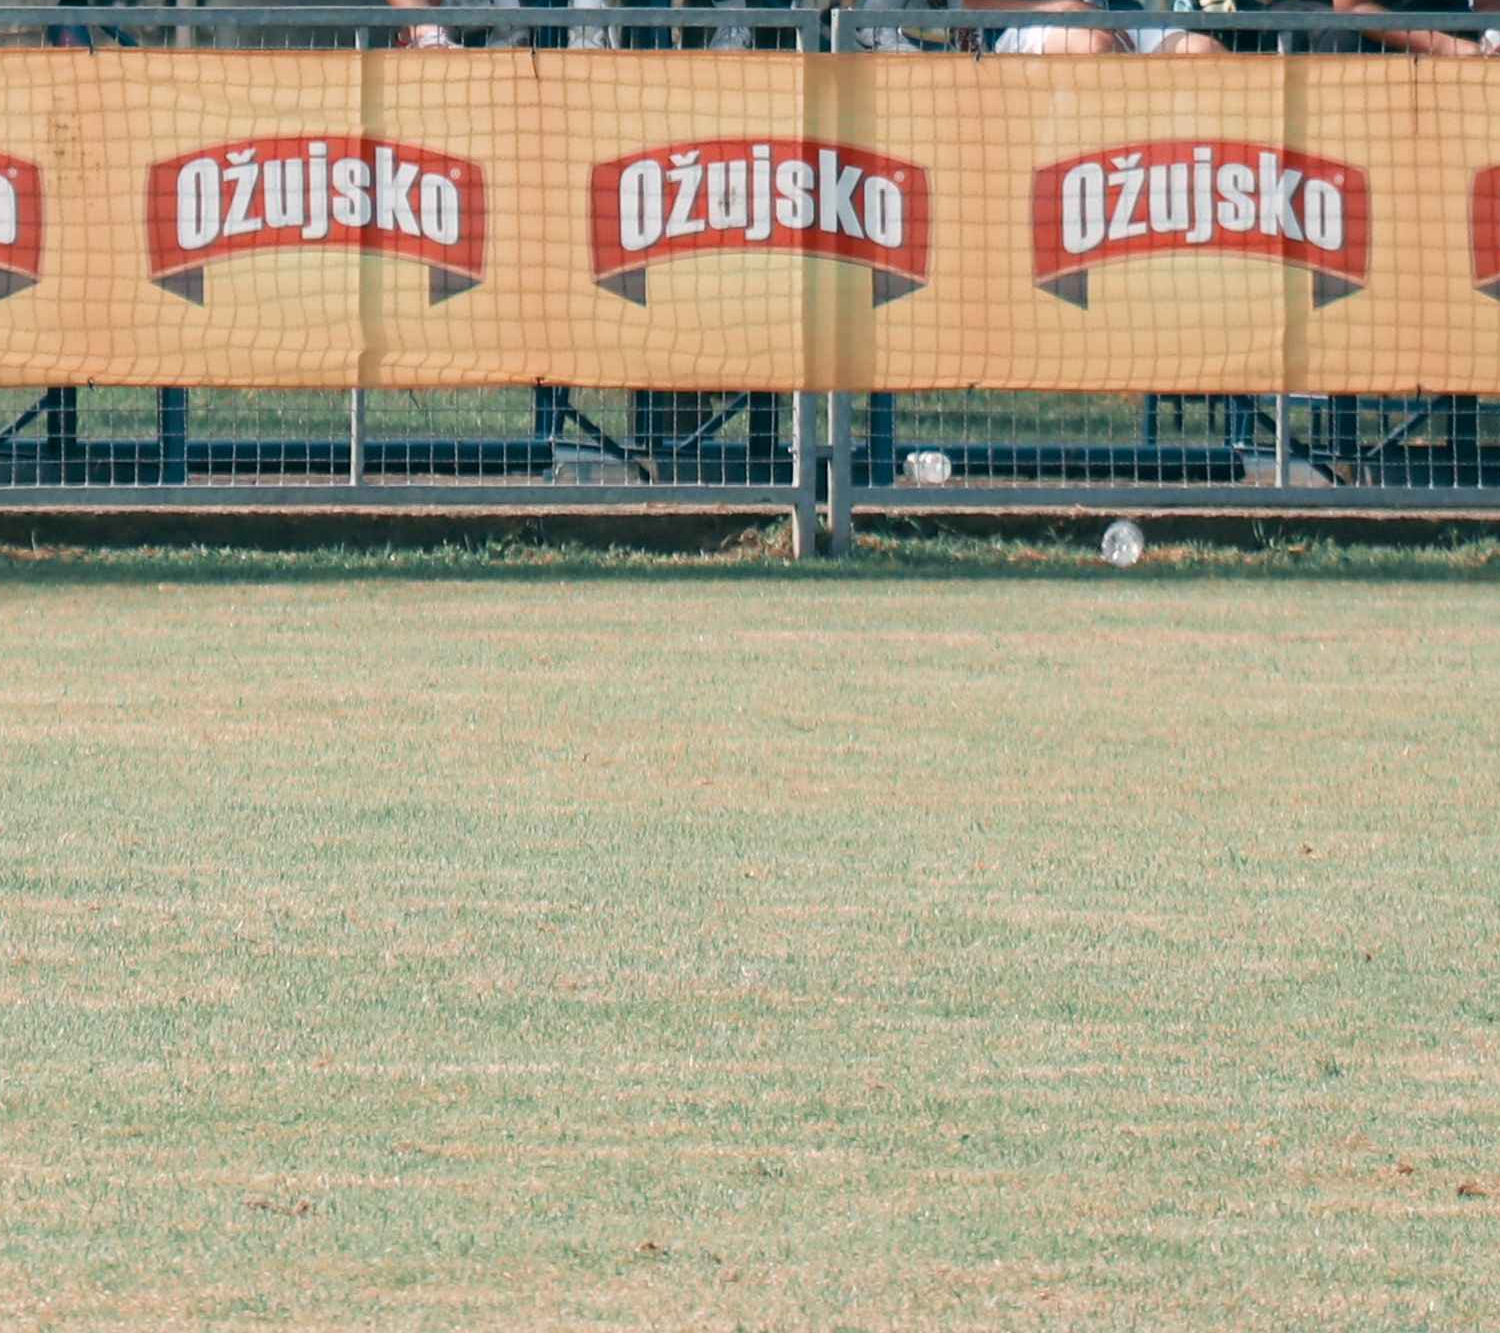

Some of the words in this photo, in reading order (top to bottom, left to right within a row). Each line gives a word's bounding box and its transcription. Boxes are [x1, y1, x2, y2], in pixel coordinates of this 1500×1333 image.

[176, 142, 460, 251] Ožujsko
[618, 144, 904, 251] Ožujsko
[1061, 147, 1343, 255] Ožujsko
